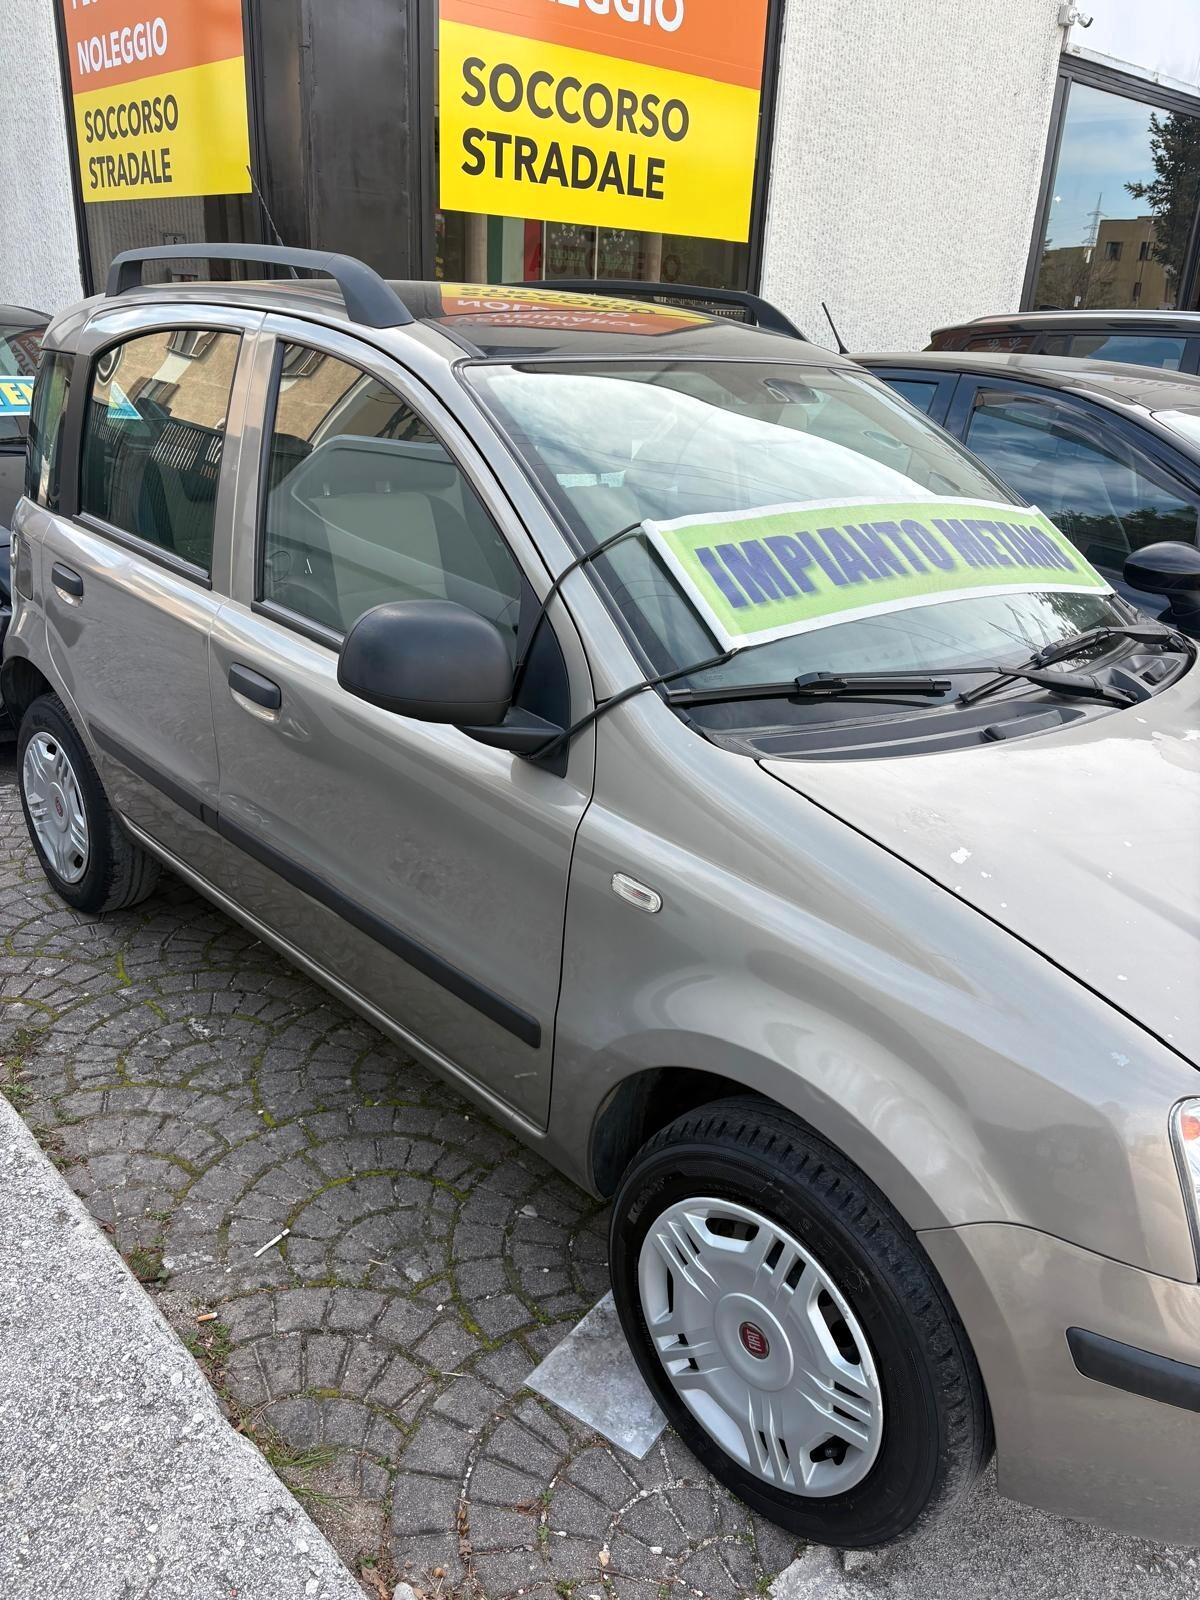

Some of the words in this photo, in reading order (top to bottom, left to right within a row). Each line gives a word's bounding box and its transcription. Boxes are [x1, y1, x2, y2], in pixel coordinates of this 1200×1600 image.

[77, 17, 168, 75] NOLEGGIO
[84, 94, 179, 143] SOCCORSO
[461, 57, 690, 142] SOCCORSO
[88, 147, 173, 189] STRADALE
[461, 127, 666, 200] STRADALE
[694, 518, 956, 609] IMPIANTO
[930, 518, 1081, 574] METANO
[746, 1327, 763, 1352] FIAT
